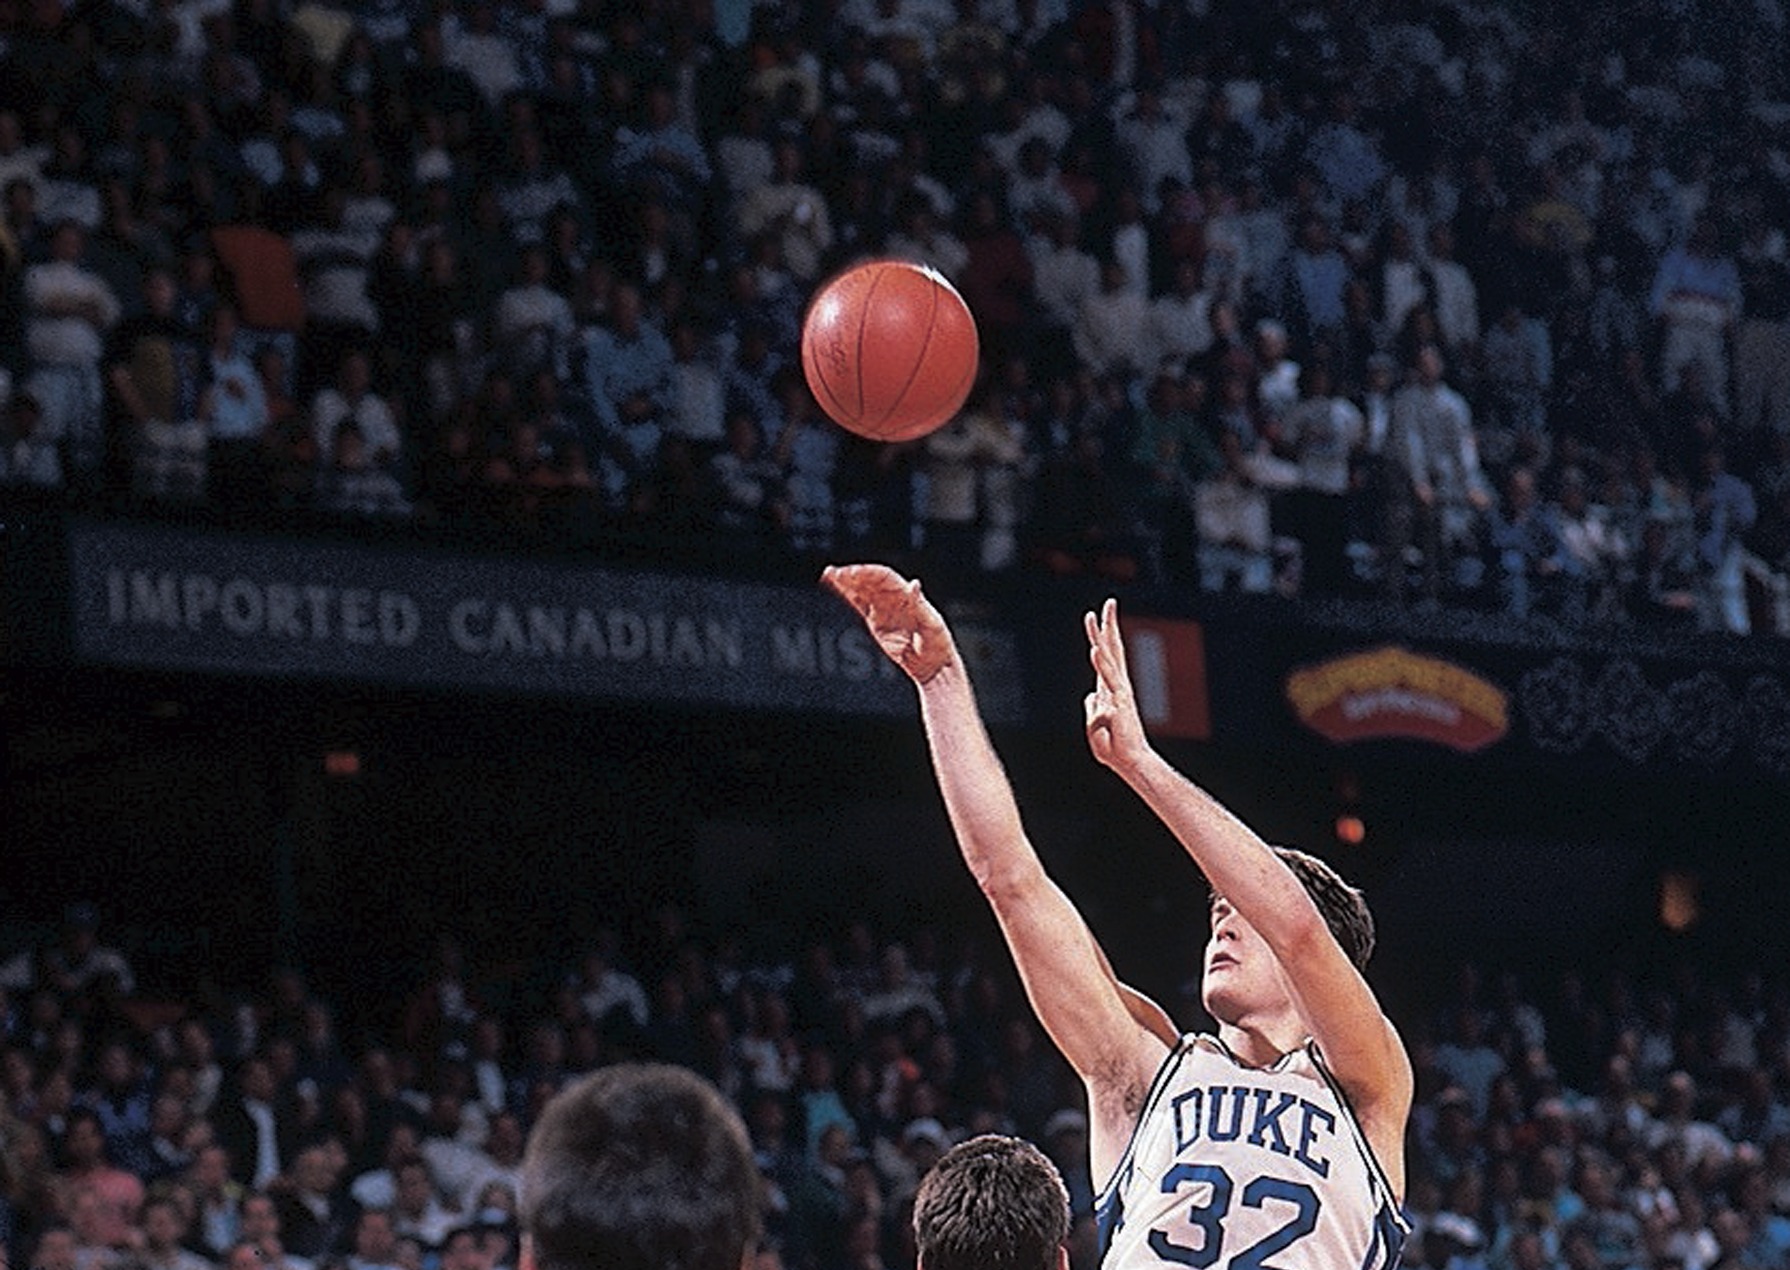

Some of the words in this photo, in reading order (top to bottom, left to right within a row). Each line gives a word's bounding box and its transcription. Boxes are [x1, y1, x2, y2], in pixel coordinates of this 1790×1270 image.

[106, 568, 421, 649] IMPORTED
[449, 597, 743, 667] CANADIAN
[768, 625, 899, 681] MIS
[1171, 1085, 1337, 1180] DUKE
